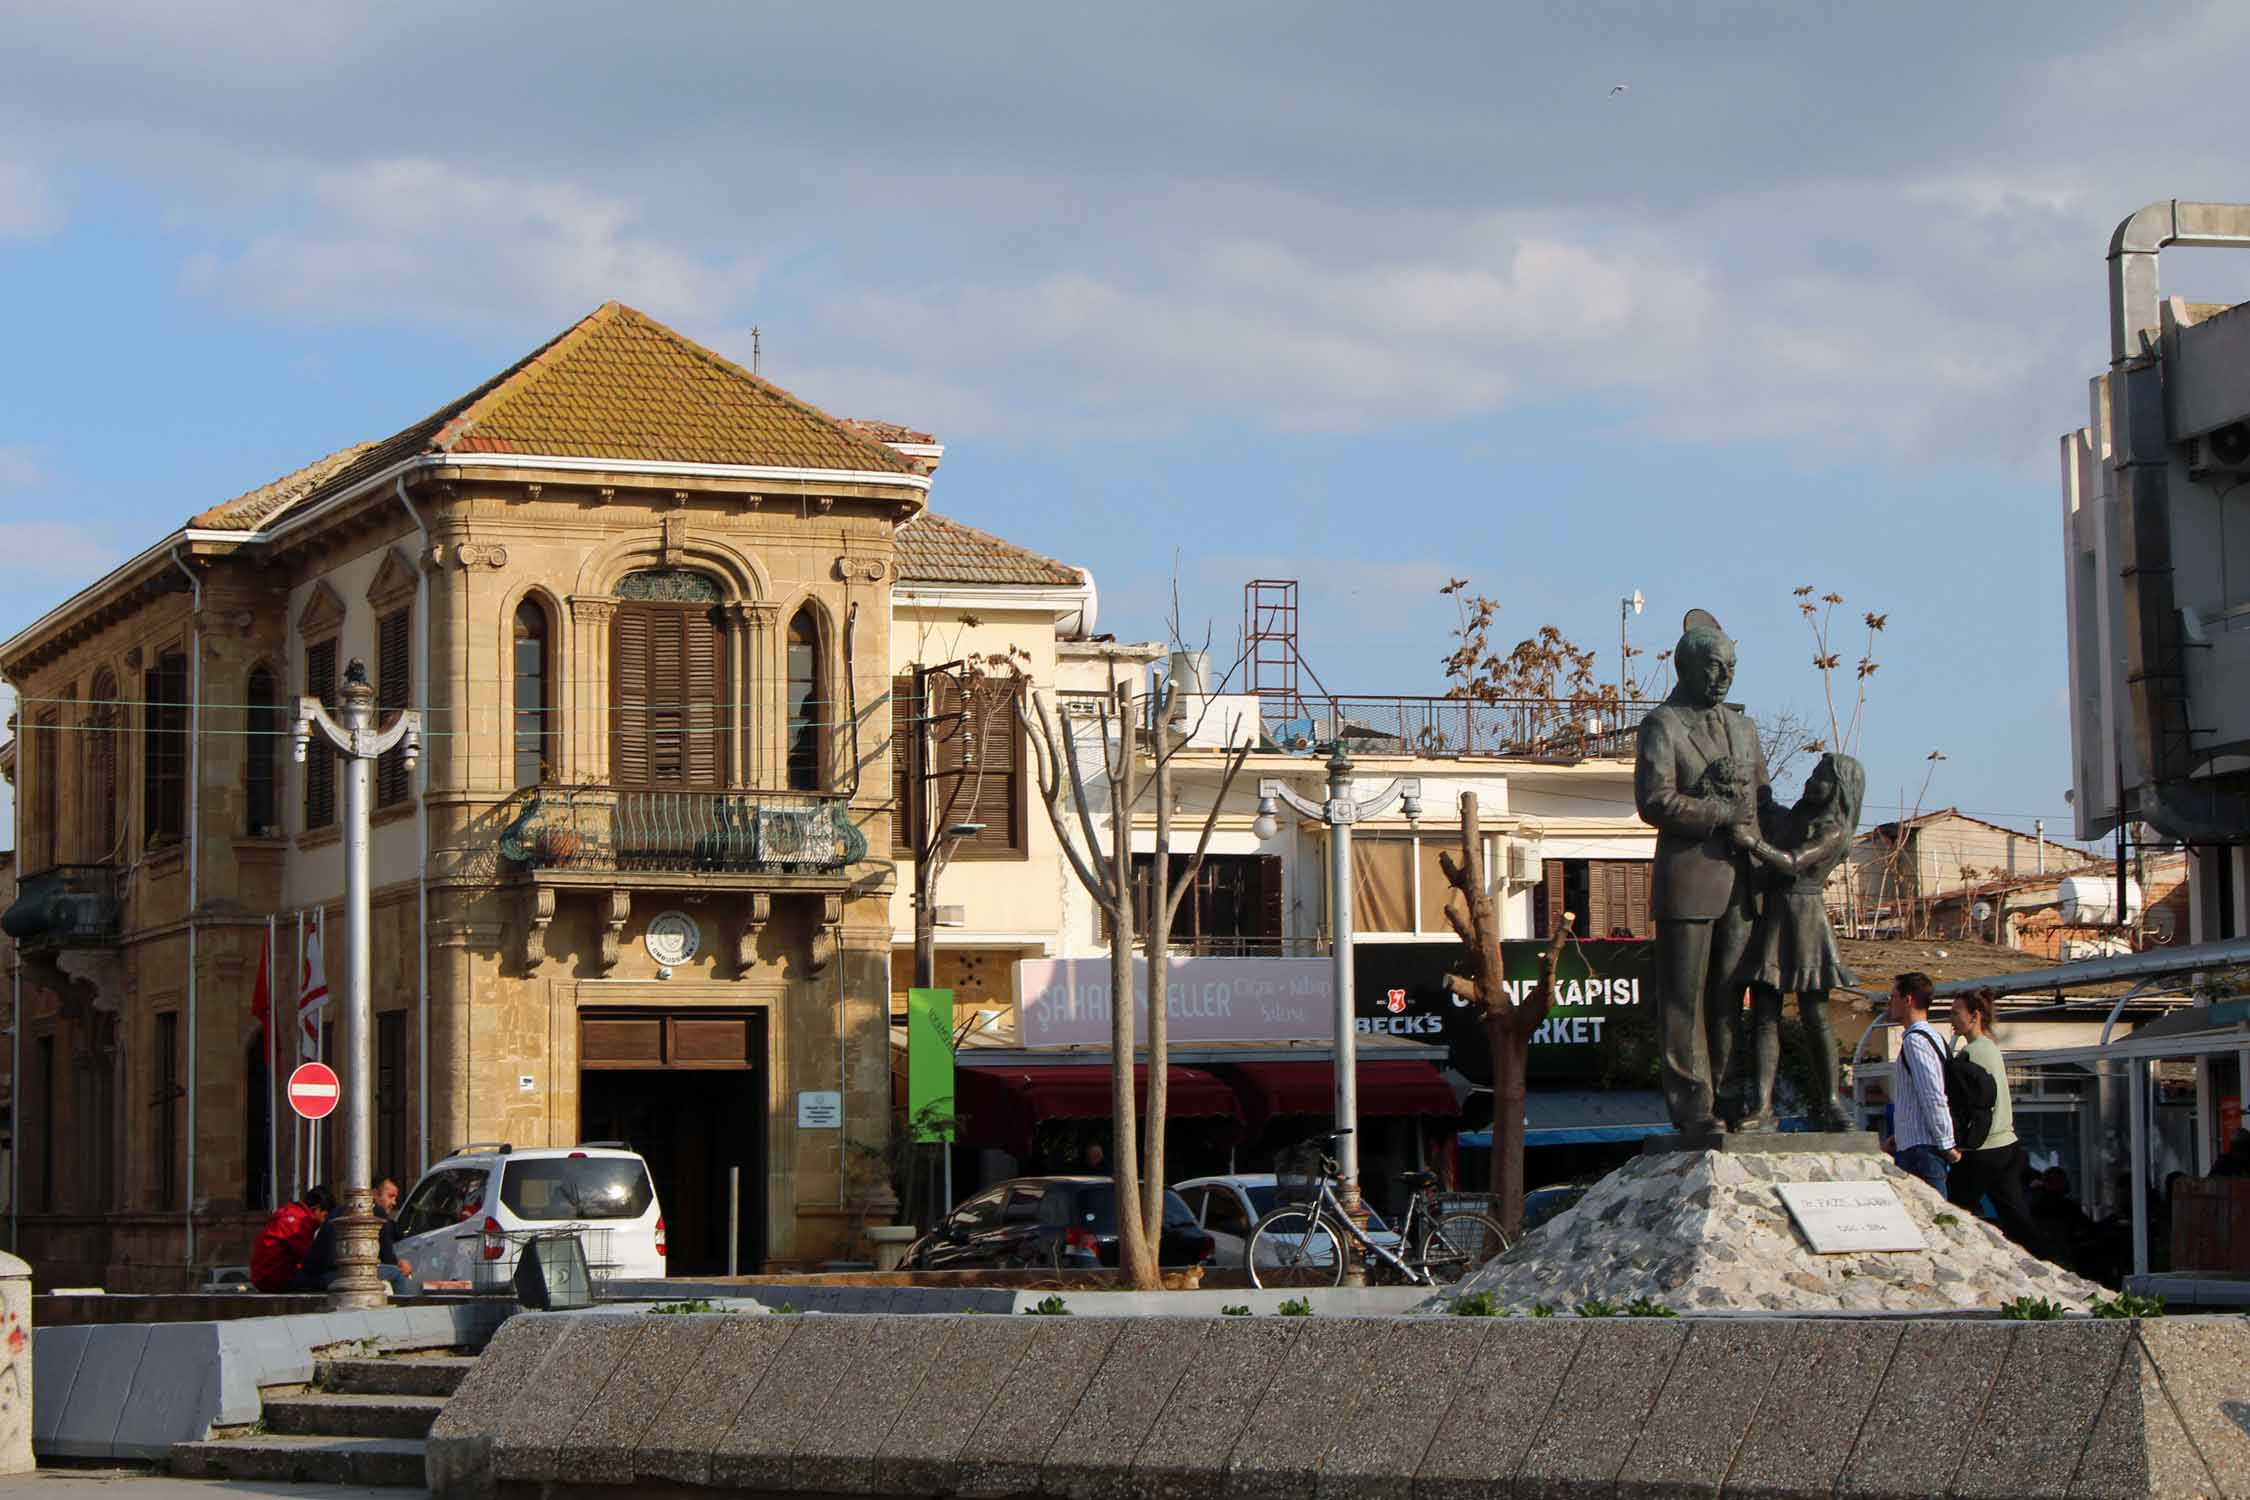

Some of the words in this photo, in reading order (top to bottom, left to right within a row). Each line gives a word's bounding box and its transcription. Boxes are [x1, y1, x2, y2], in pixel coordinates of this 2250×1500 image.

[1553, 977, 1640, 1007] KAPISI
[1355, 1012, 1443, 1034] BECK'S
[1527, 1016, 1606, 1044] RKET
